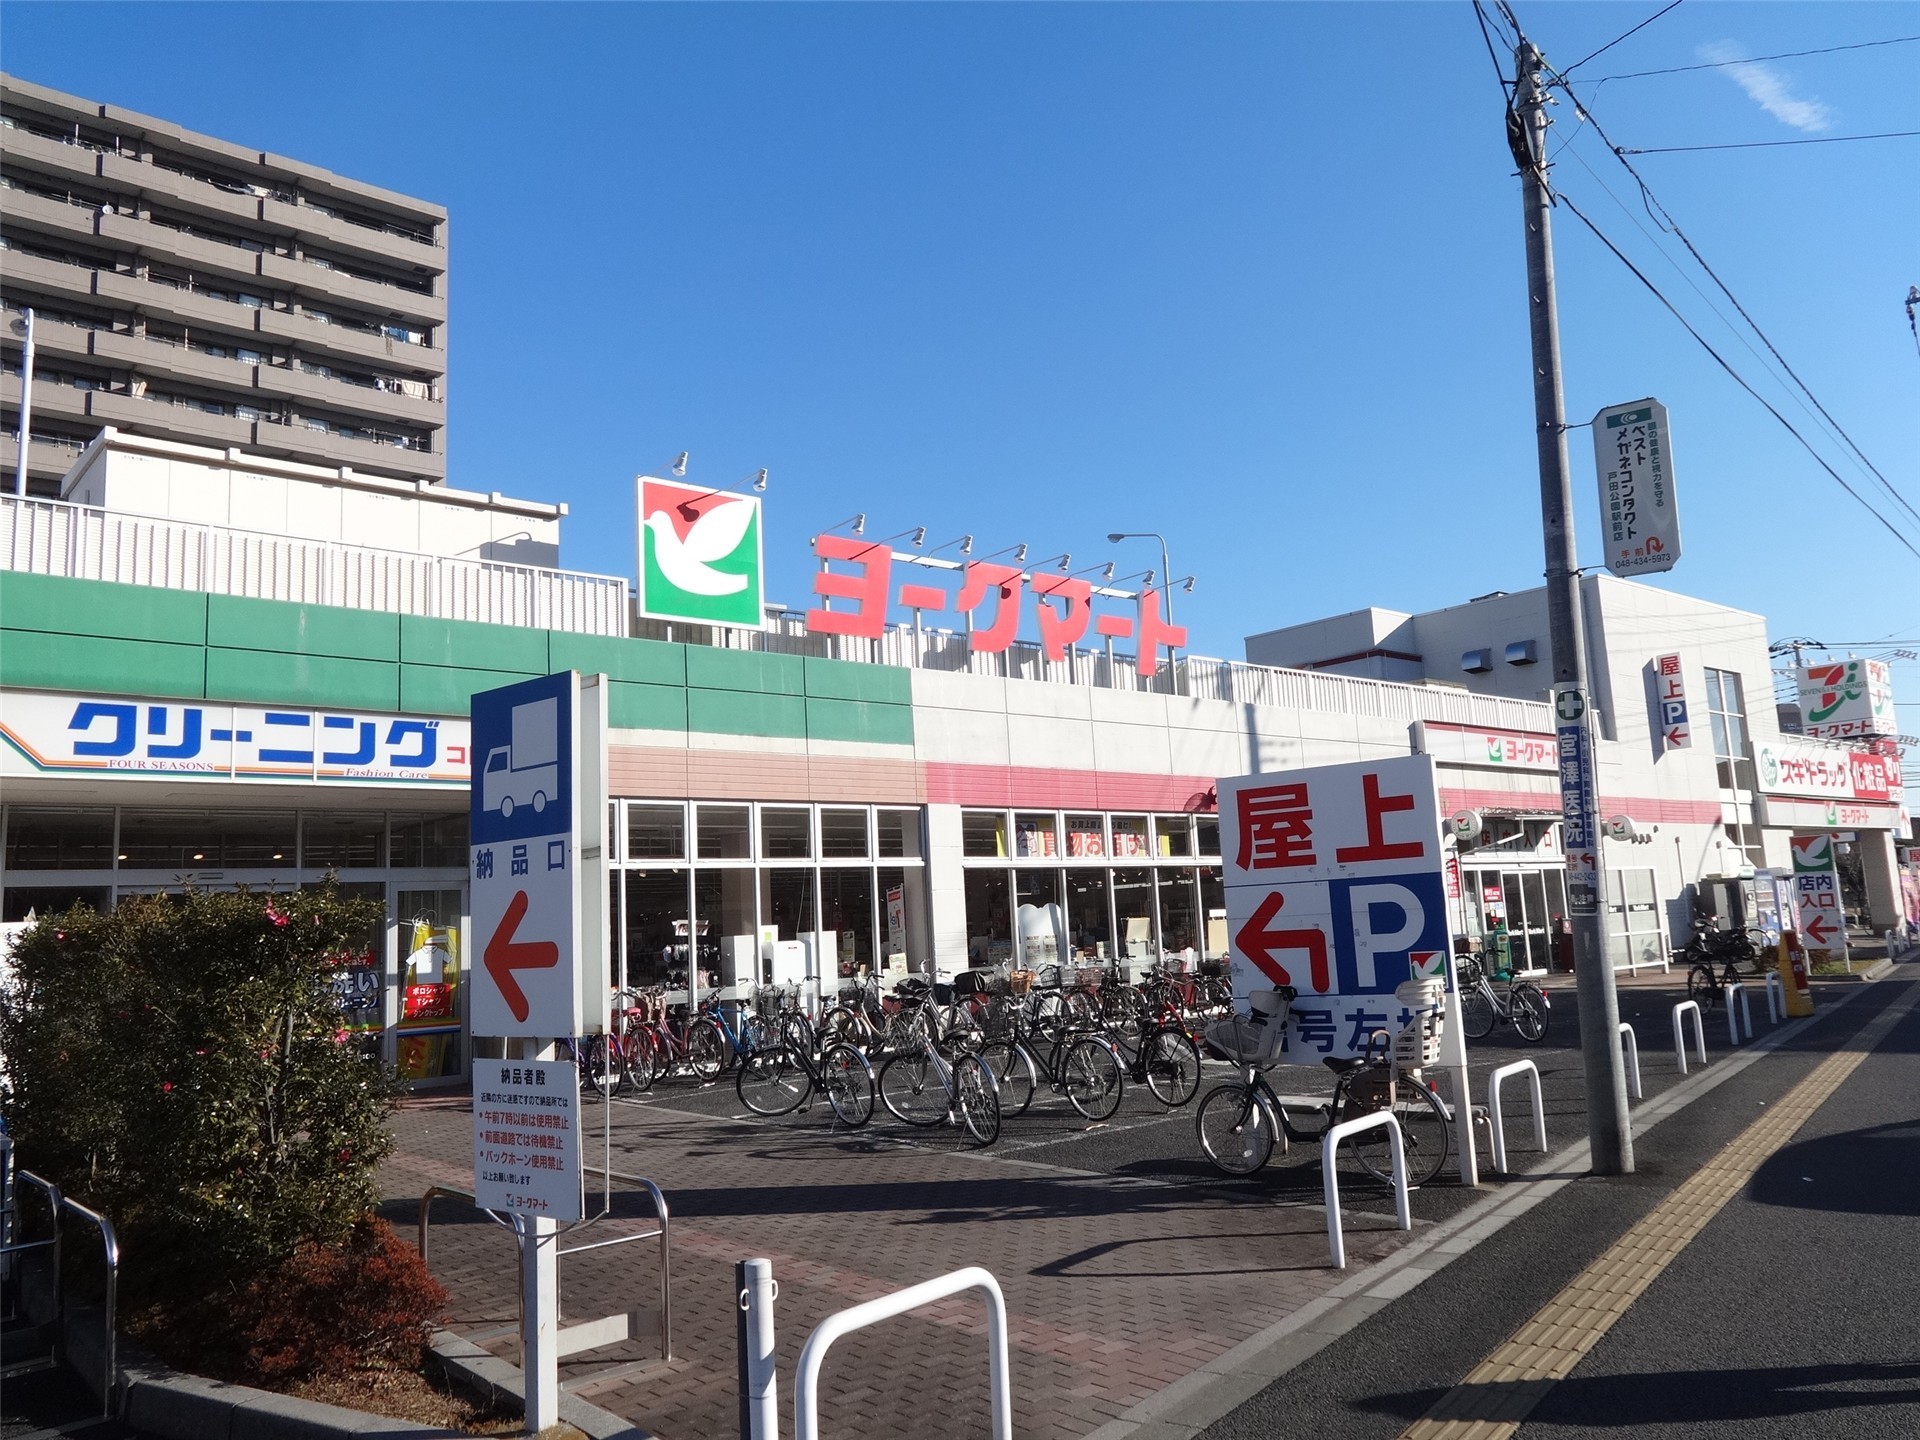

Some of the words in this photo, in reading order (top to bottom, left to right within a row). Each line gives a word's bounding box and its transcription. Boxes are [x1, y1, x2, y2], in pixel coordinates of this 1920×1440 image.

[1632, 425, 1646, 466] ベスト
[1617, 428, 1637, 539] メガネコンタクト
[1608, 472, 1623, 542] 戸田公園駅前店
[1615, 553, 1671, 569] 048-434-5973
[1621, 548, 1644, 558] 手前
[806, 535, 1187, 676] ヨークマート
[1660, 655, 1683, 699] 屋上
[1667, 703, 1683, 723] P
[67, 702, 440, 768] クリーニング
[1807, 720, 1872, 738] ヨークマート
[447, 746, 471, 764] コ
[1506, 740, 1557, 764] ヨークマート
[109, 759, 148, 768] FOUR
[151, 761, 214, 771] SEASONS
[344, 768, 396, 778] Fashion
[400, 770, 428, 779] Care
[1780, 758, 1847, 787] スギドラッグ
[1853, 761, 1887, 791] 化粧品
[1560, 732, 1583, 843] 宮澤医院
[1236, 774, 1424, 871] 屋上
[476, 840, 565, 880] 納品口
[1799, 874, 1833, 891] 店内
[1801, 893, 1835, 908] 入口
[1349, 883, 1426, 988] P
[412, 986, 446, 996] ポロシャツ
[416, 997, 441, 1006] Tシャツ
[413, 1008, 445, 1018] タンクトップ
[501, 1068, 546, 1086] 納品者殿
[484, 1111, 569, 1129] 午前7時以前は使用禁止
[484, 1131, 563, 1150] 前面道路では待機禁止
[485, 1151, 564, 1171] バックホーン使用禁止
[516, 1196, 548, 1210] ヨークマート
